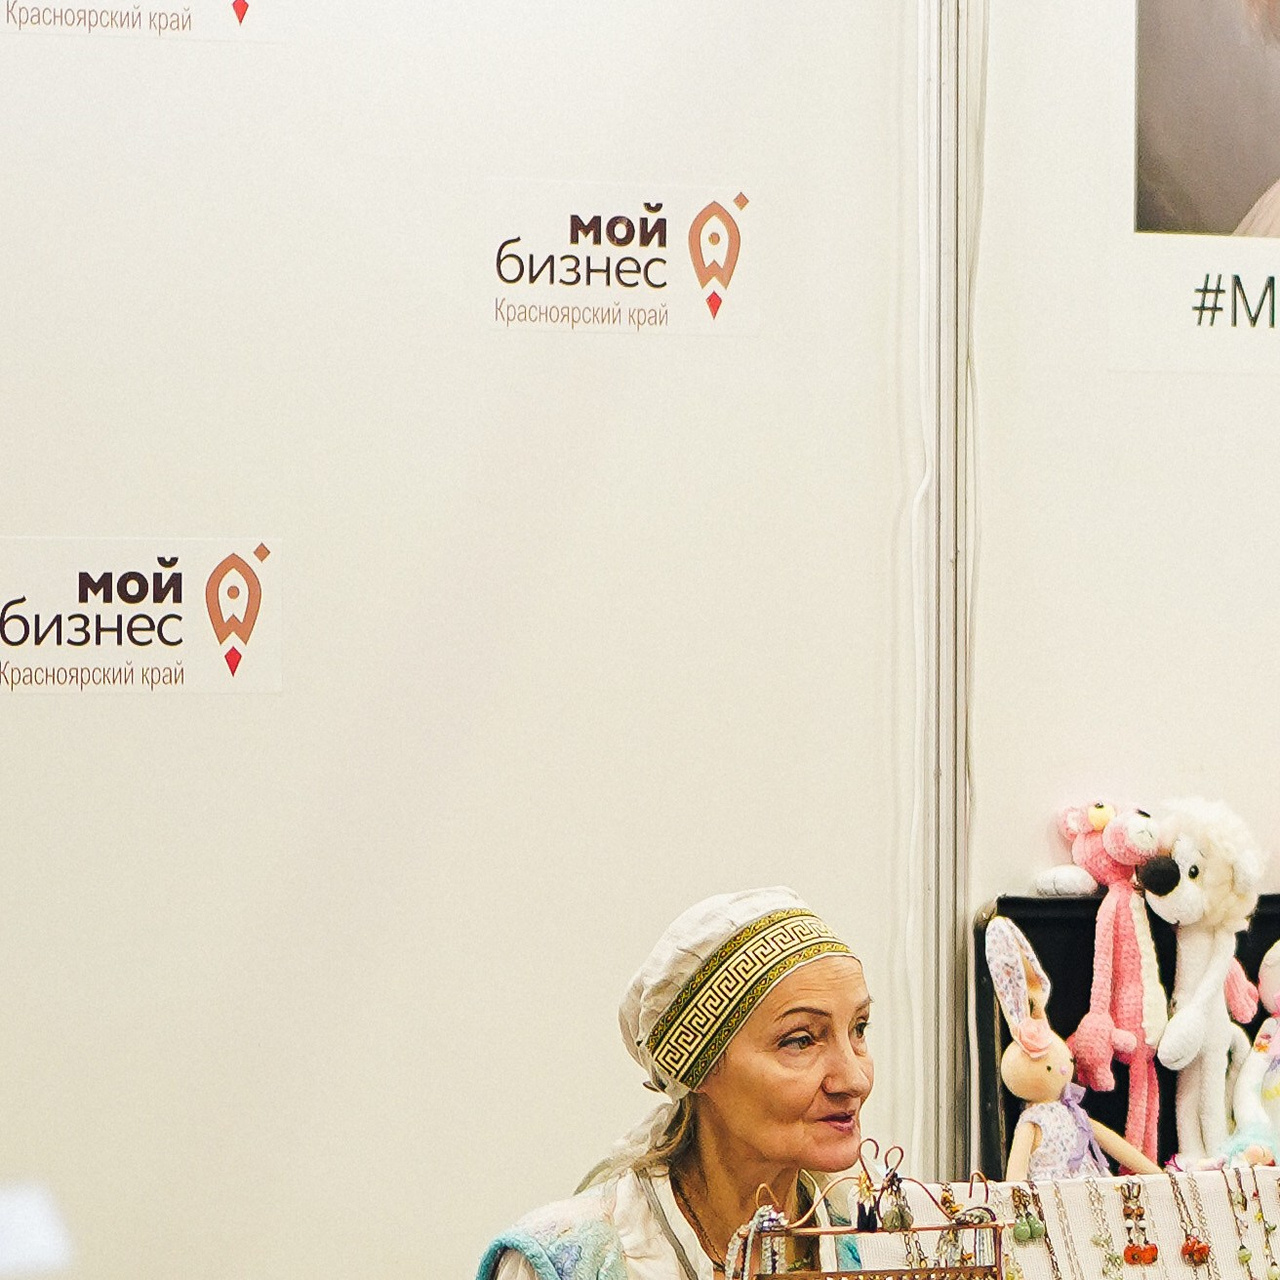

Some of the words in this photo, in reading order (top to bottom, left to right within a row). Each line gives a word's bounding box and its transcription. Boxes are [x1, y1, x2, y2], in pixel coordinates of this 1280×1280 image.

[6, 0, 142, 34] Красноярский
[149, 7, 192, 37] край
[569, 202, 667, 249] мой
[495, 236, 668, 289] бизнес
[494, 297, 622, 331] Красноярский
[628, 303, 669, 332] край
[78, 556, 183, 604] мой
[0, 595, 184, 647] бизнес
[0, 659, 135, 691] Красноярский
[141, 659, 185, 691] край
